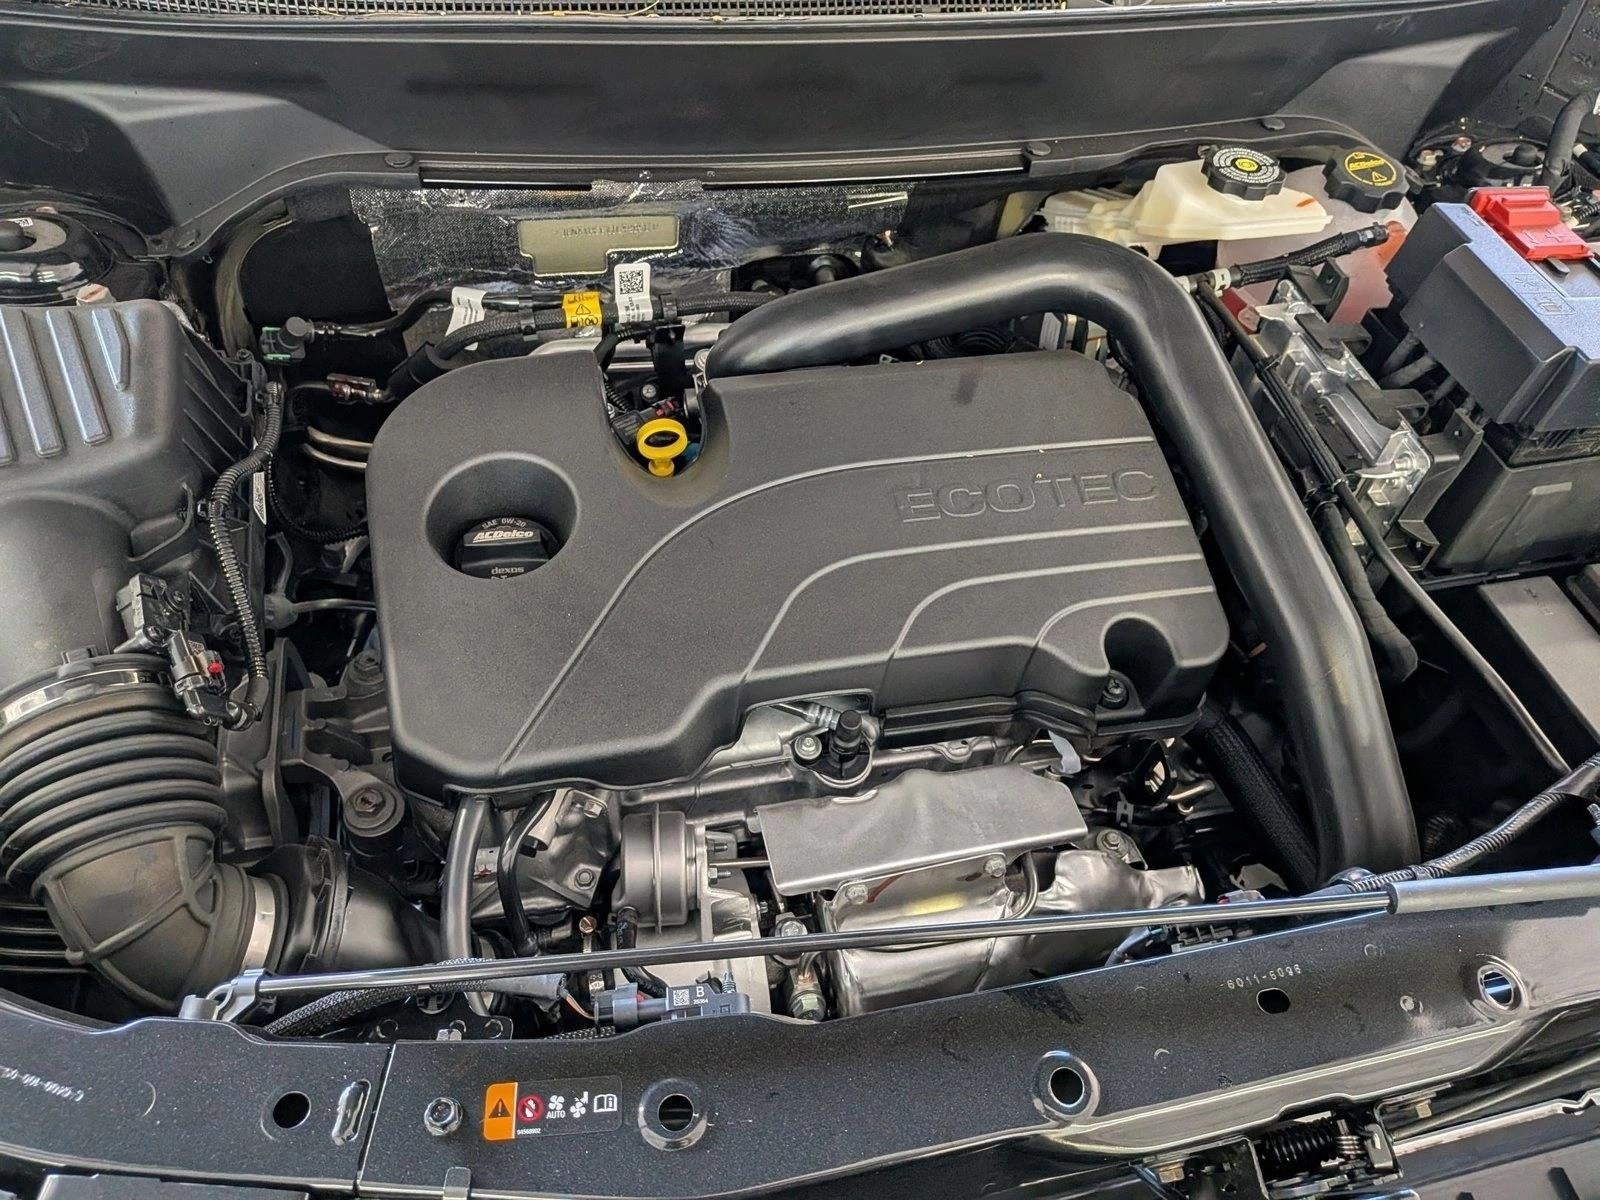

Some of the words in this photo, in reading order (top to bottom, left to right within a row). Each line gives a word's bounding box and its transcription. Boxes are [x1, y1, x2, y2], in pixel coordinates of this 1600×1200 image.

[898, 468, 1159, 524] ECOTEC
[482, 520, 498, 529] SAE
[501, 518, 526, 528] 0W-20
[473, 529, 533, 542] ACDelco
[697, 986, 705, 997] B
[546, 1110, 566, 1119] AUTO
